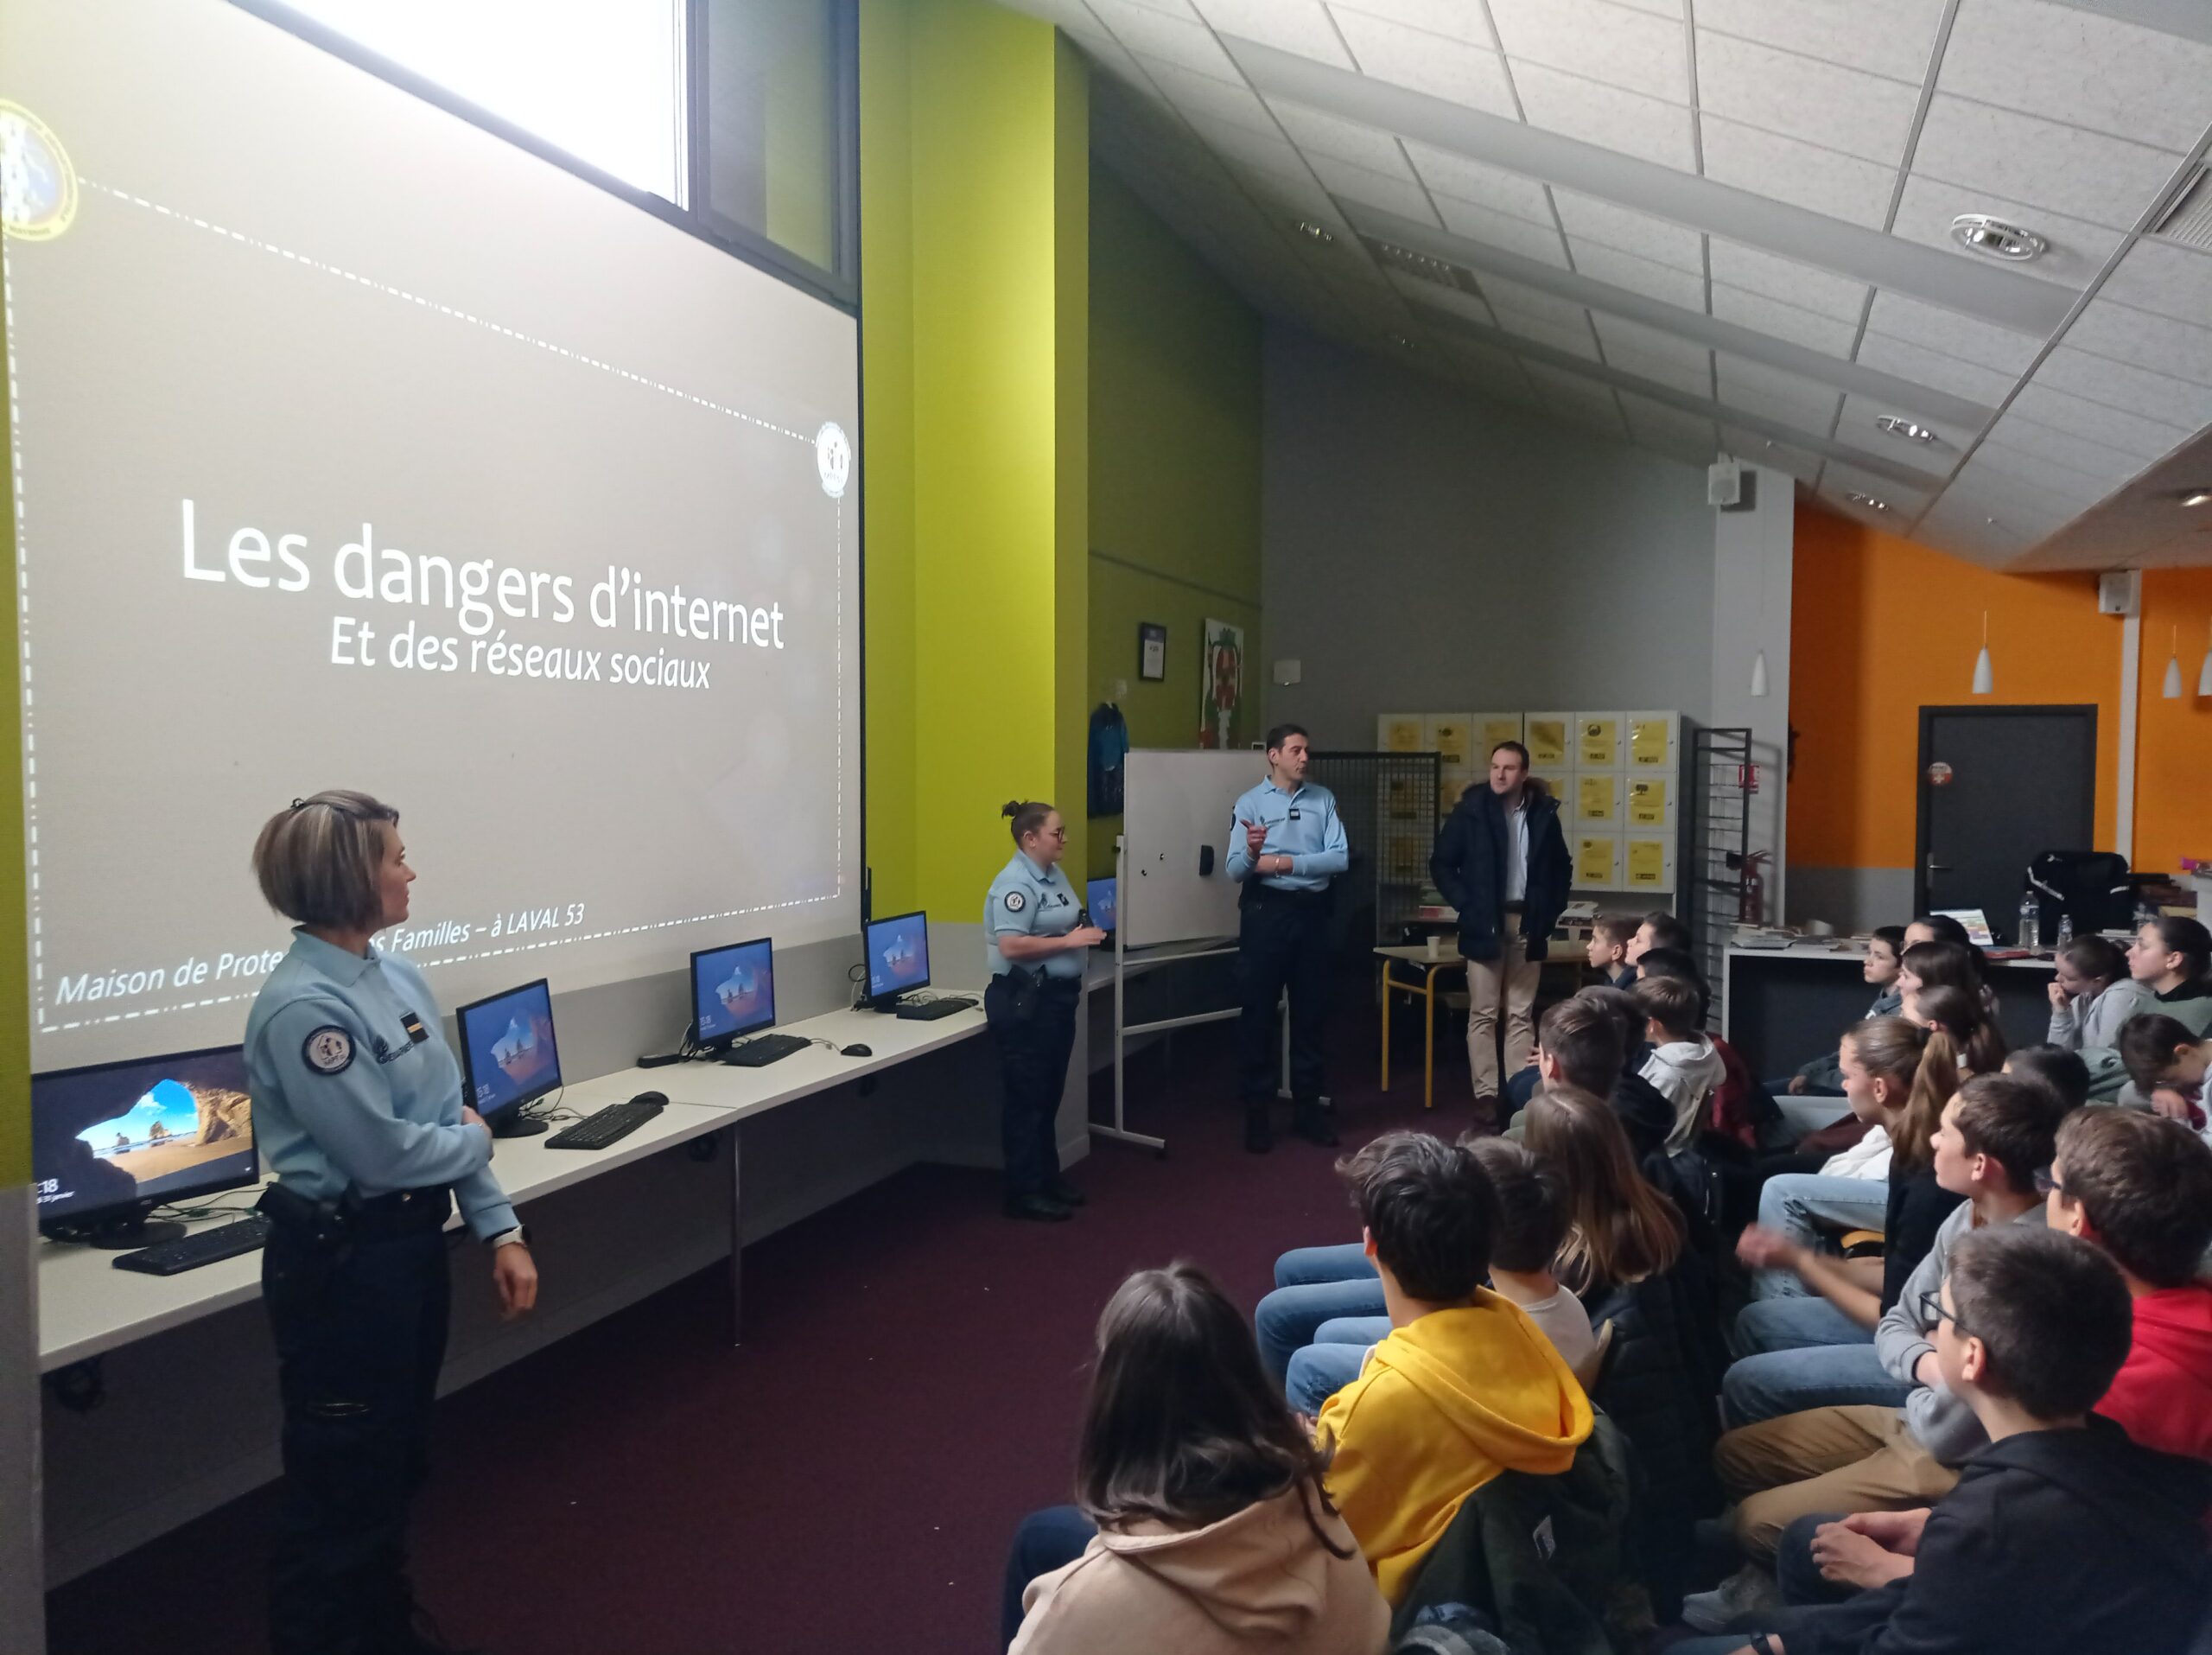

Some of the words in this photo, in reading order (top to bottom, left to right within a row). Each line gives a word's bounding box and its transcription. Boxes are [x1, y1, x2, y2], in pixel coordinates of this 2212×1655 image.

[181, 498, 310, 592] Les
[334, 522, 575, 636] dangers
[331, 615, 376, 667] Et
[389, 620, 459, 672] des
[470, 628, 602, 682] réseaux
[609, 646, 711, 690] sociaux
[54, 968, 166, 1006] Maison
[173, 956, 209, 988] de
[214, 949, 284, 981] Prote
[391, 920, 471, 952] Familles
[489, 913, 503, 938] à
[505, 907, 560, 935] LAVAL
[563, 902, 585, 926] 53
